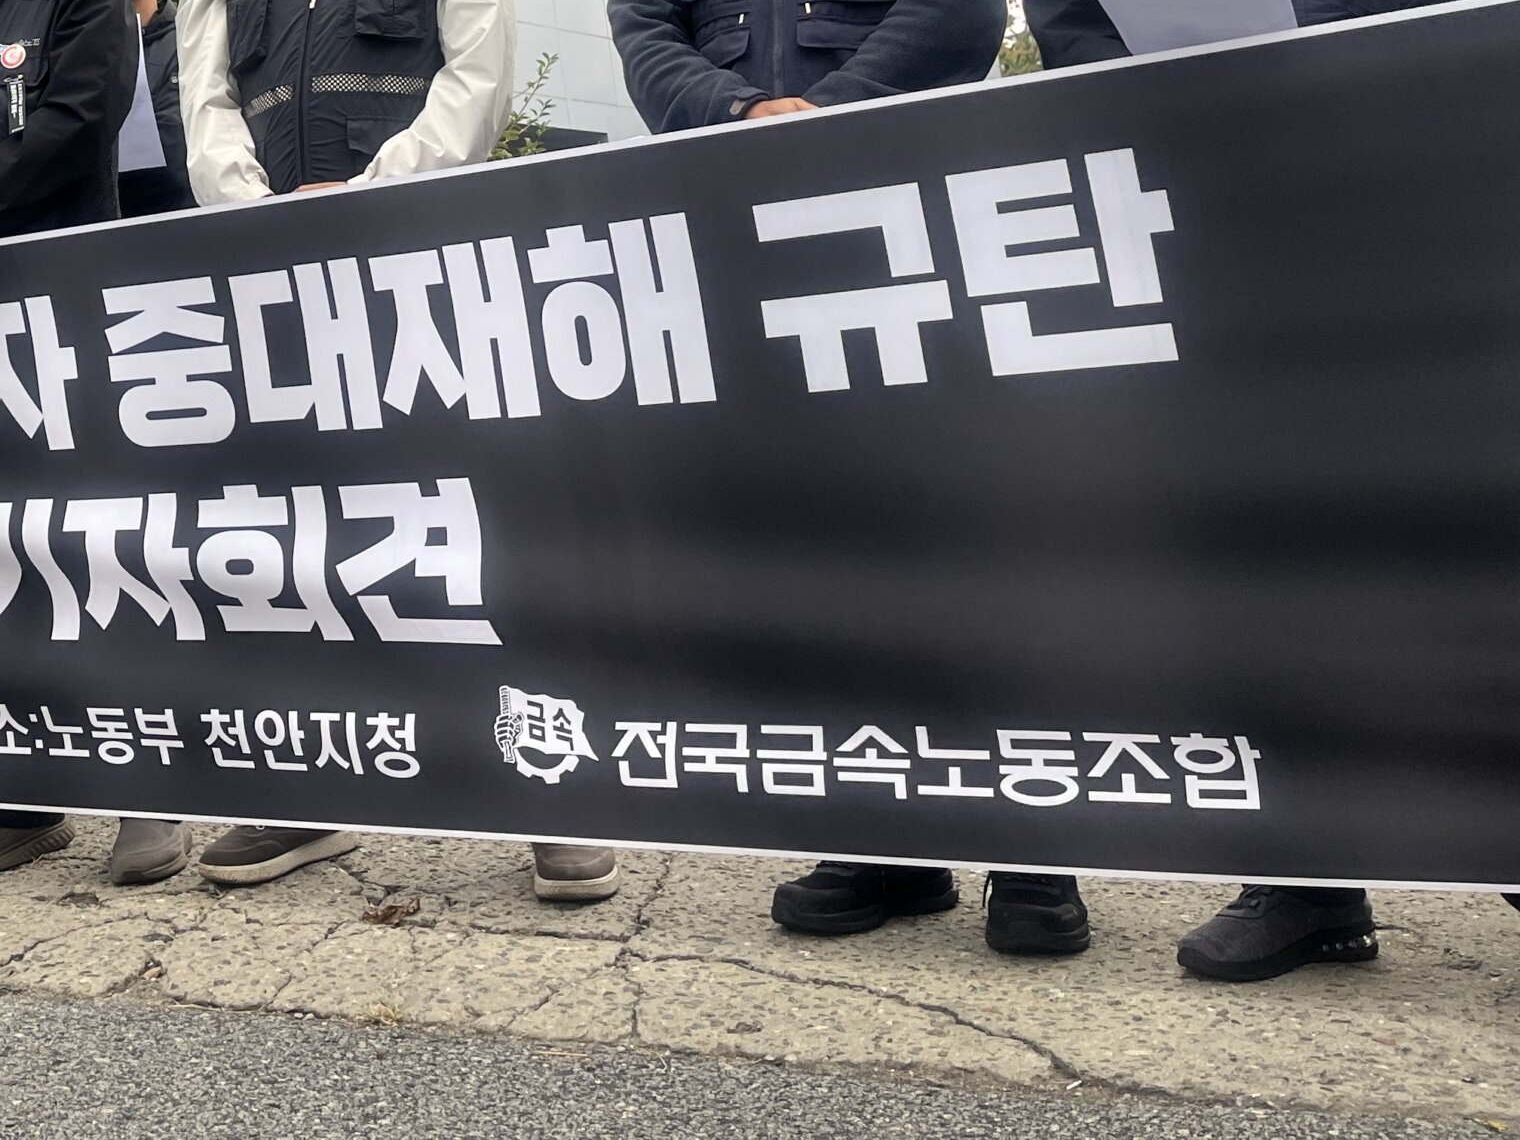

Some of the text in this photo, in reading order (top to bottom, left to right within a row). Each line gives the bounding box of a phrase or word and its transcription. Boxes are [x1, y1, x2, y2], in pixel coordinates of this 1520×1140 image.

[101, 211, 718, 448] 중대재해
[751, 147, 1180, 393] 규탄
[200, 708, 421, 779] 천안지청
[610, 721, 1262, 810] 전국금속노동조합
